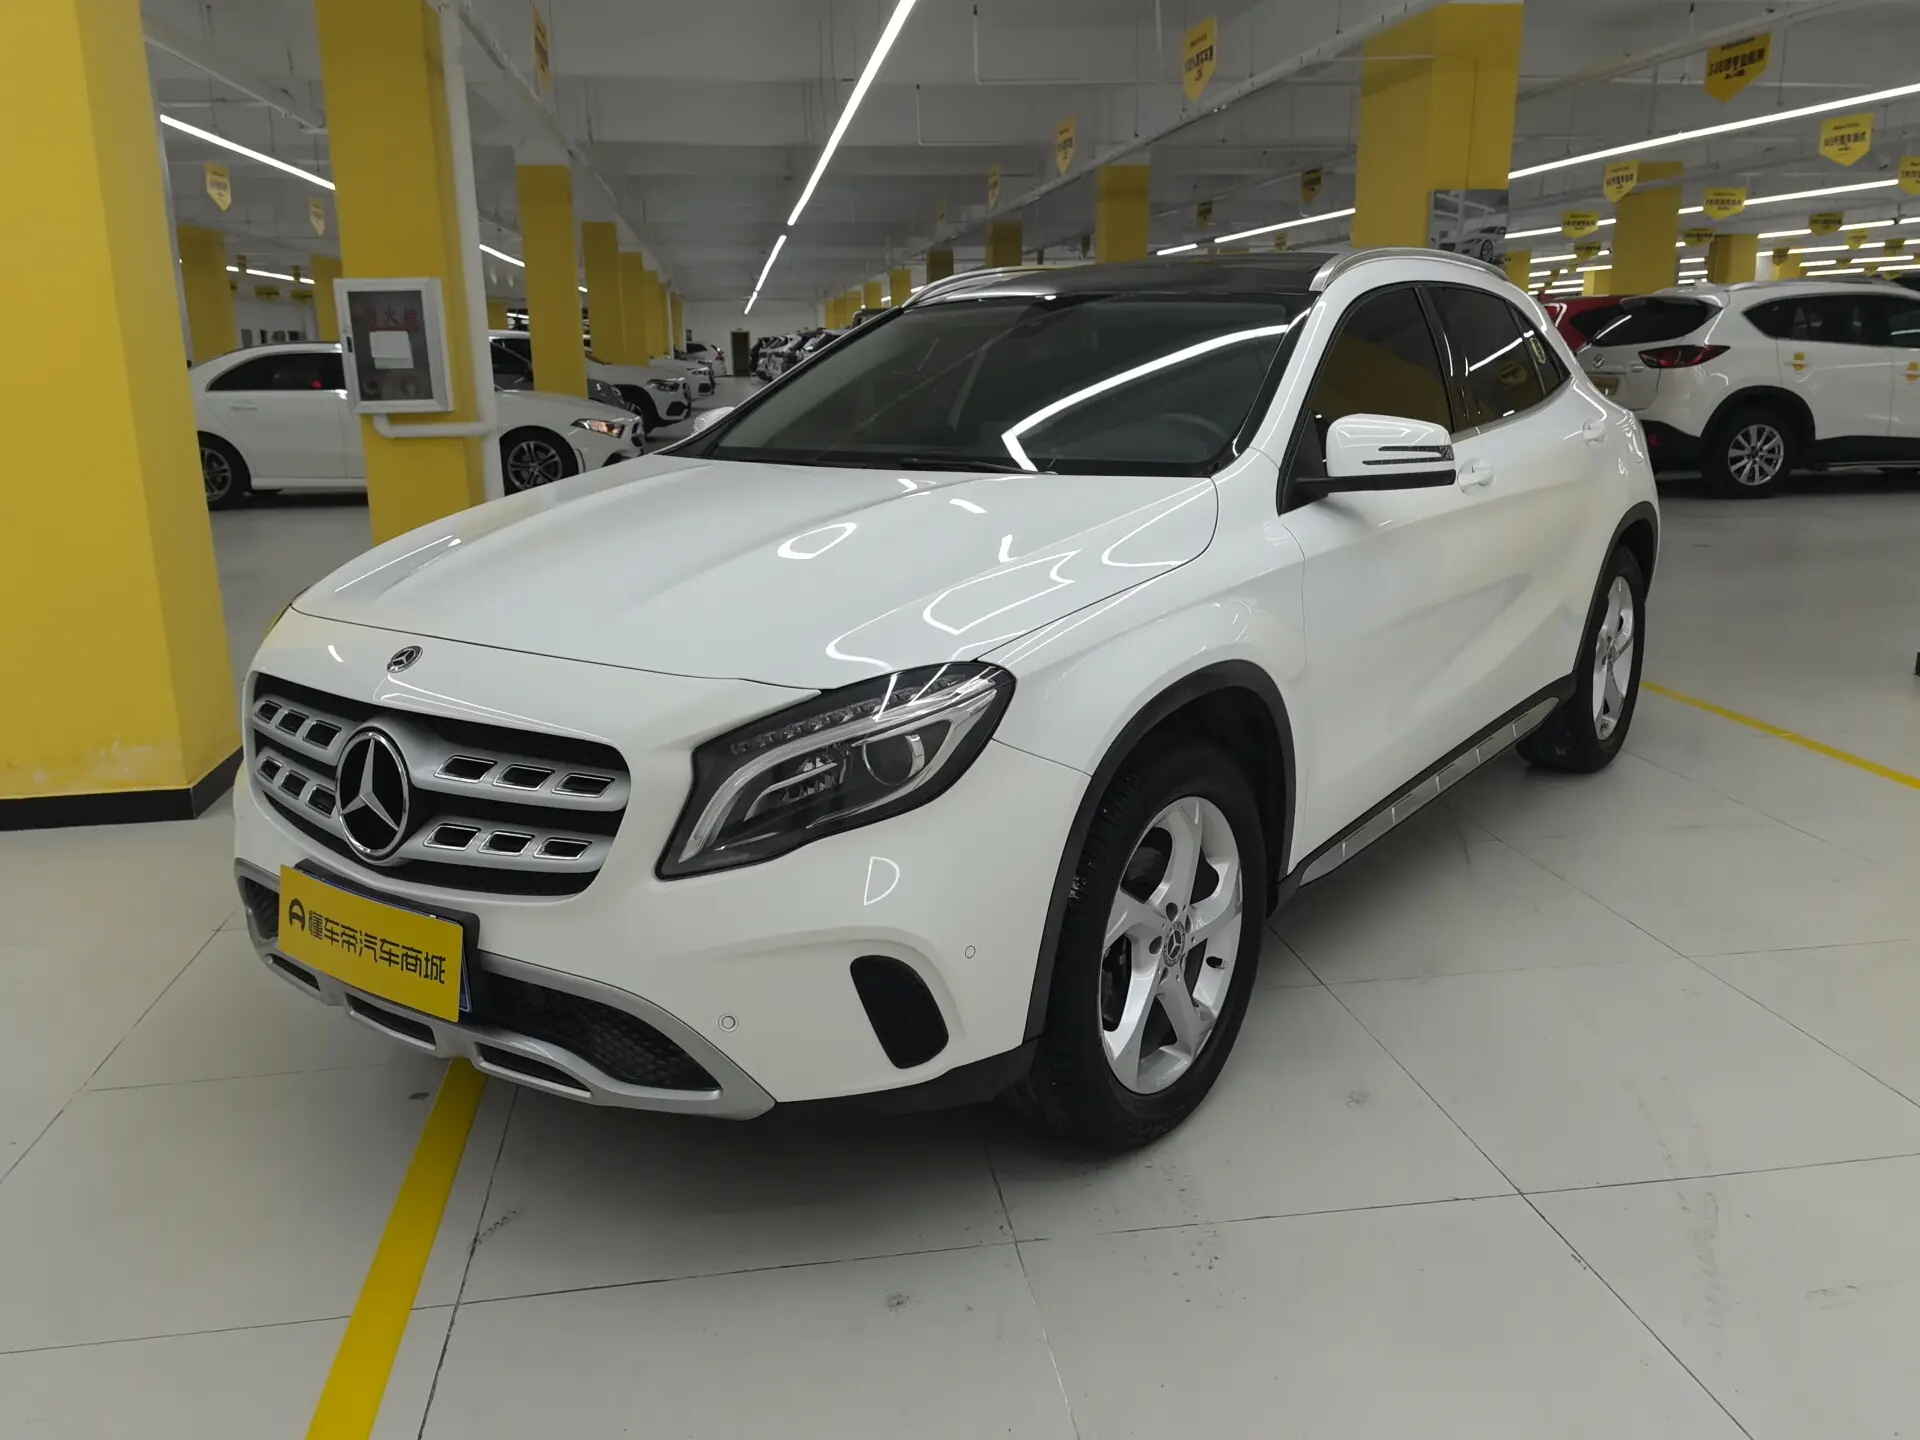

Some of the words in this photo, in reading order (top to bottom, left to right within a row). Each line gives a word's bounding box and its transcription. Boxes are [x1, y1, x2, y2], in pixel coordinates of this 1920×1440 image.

[308, 910, 446, 984] 懂车帝汽车商城
